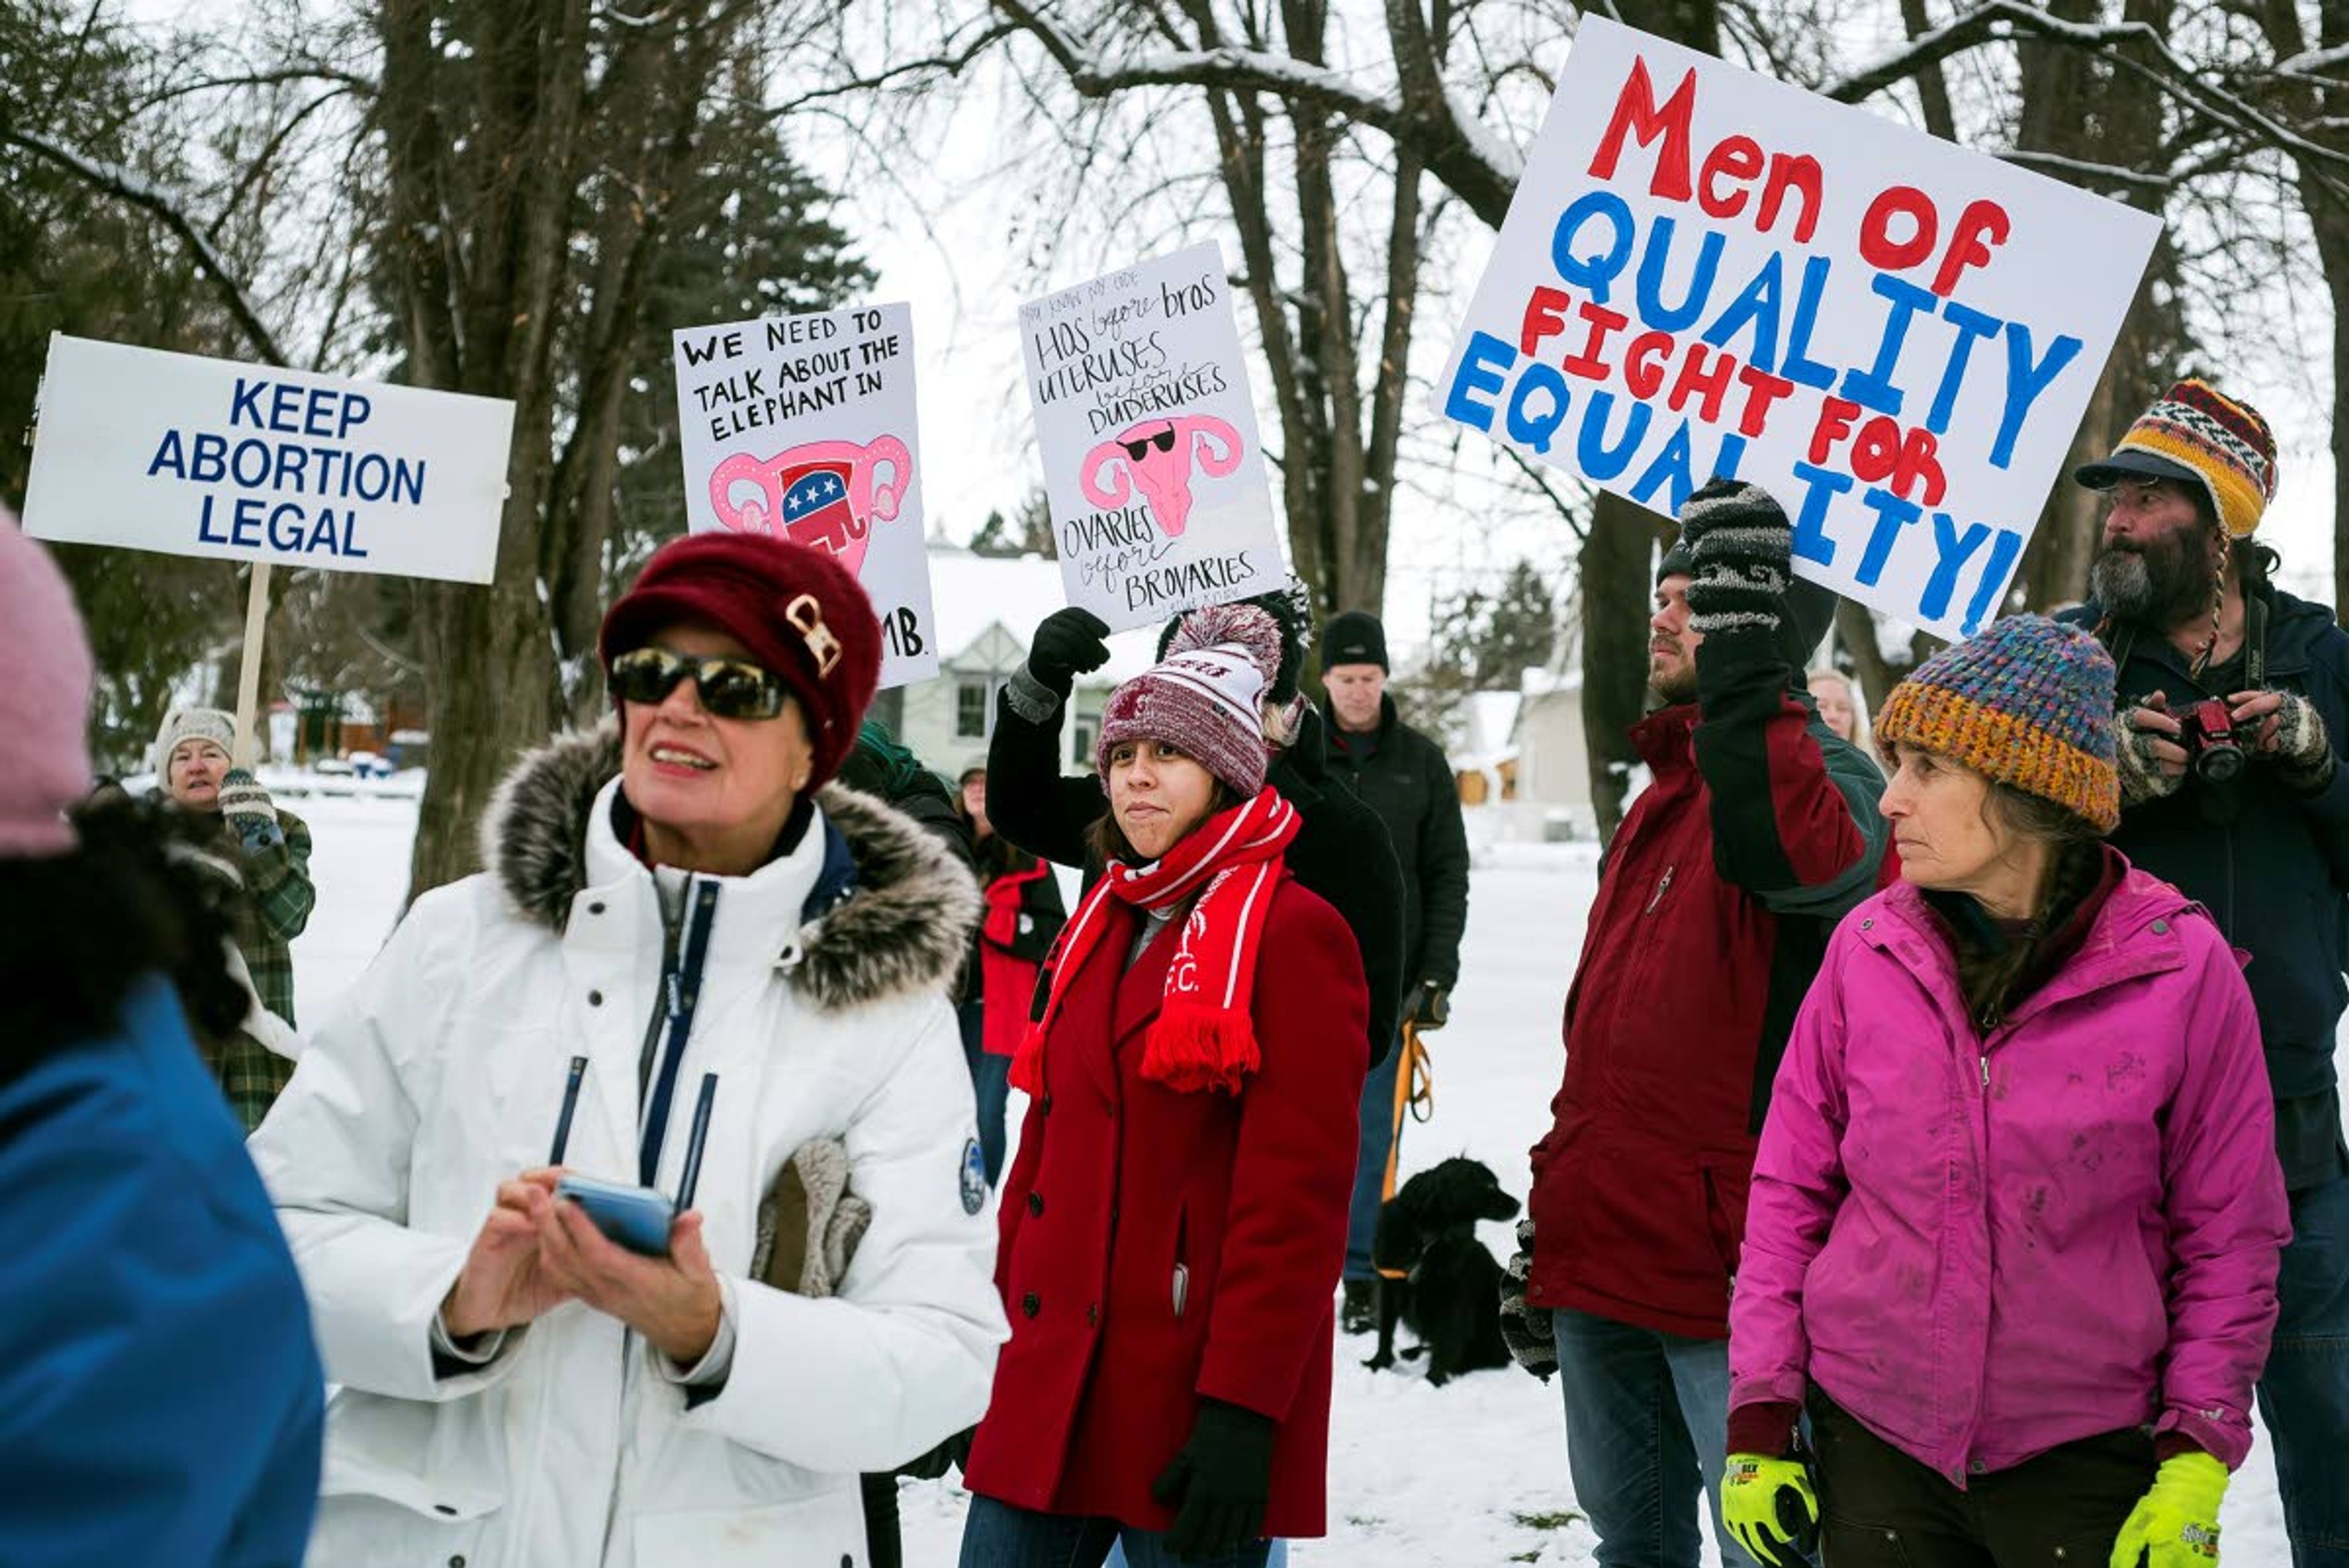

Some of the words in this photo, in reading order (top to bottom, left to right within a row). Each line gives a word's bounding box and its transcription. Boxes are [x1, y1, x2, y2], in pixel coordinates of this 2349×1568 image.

[1588, 54, 1823, 243] Men
[681, 333, 743, 366] WE
[767, 317, 837, 351] NEED
[852, 309, 881, 333] TO
[1093, 297, 1160, 341] before
[1161, 274, 1216, 318] bros
[1552, 190, 2082, 469] QUALITY
[693, 368, 765, 412] TALK
[779, 347, 851, 388] ABOUT
[859, 335, 899, 365] THE
[1039, 331, 1166, 404] UTERUSES
[1088, 366, 1226, 434] DUDERUSES
[1521, 286, 1794, 437] FIGHT
[1808, 395, 1946, 505] FOR
[229, 377, 371, 439] KEEP
[711, 376, 848, 441] ELEPHANT
[855, 370, 882, 396] IN
[147, 429, 426, 505] ABORTION
[198, 495, 369, 557] LEGAL
[1064, 505, 1154, 558] OVARIES
[1080, 542, 1175, 594] before
